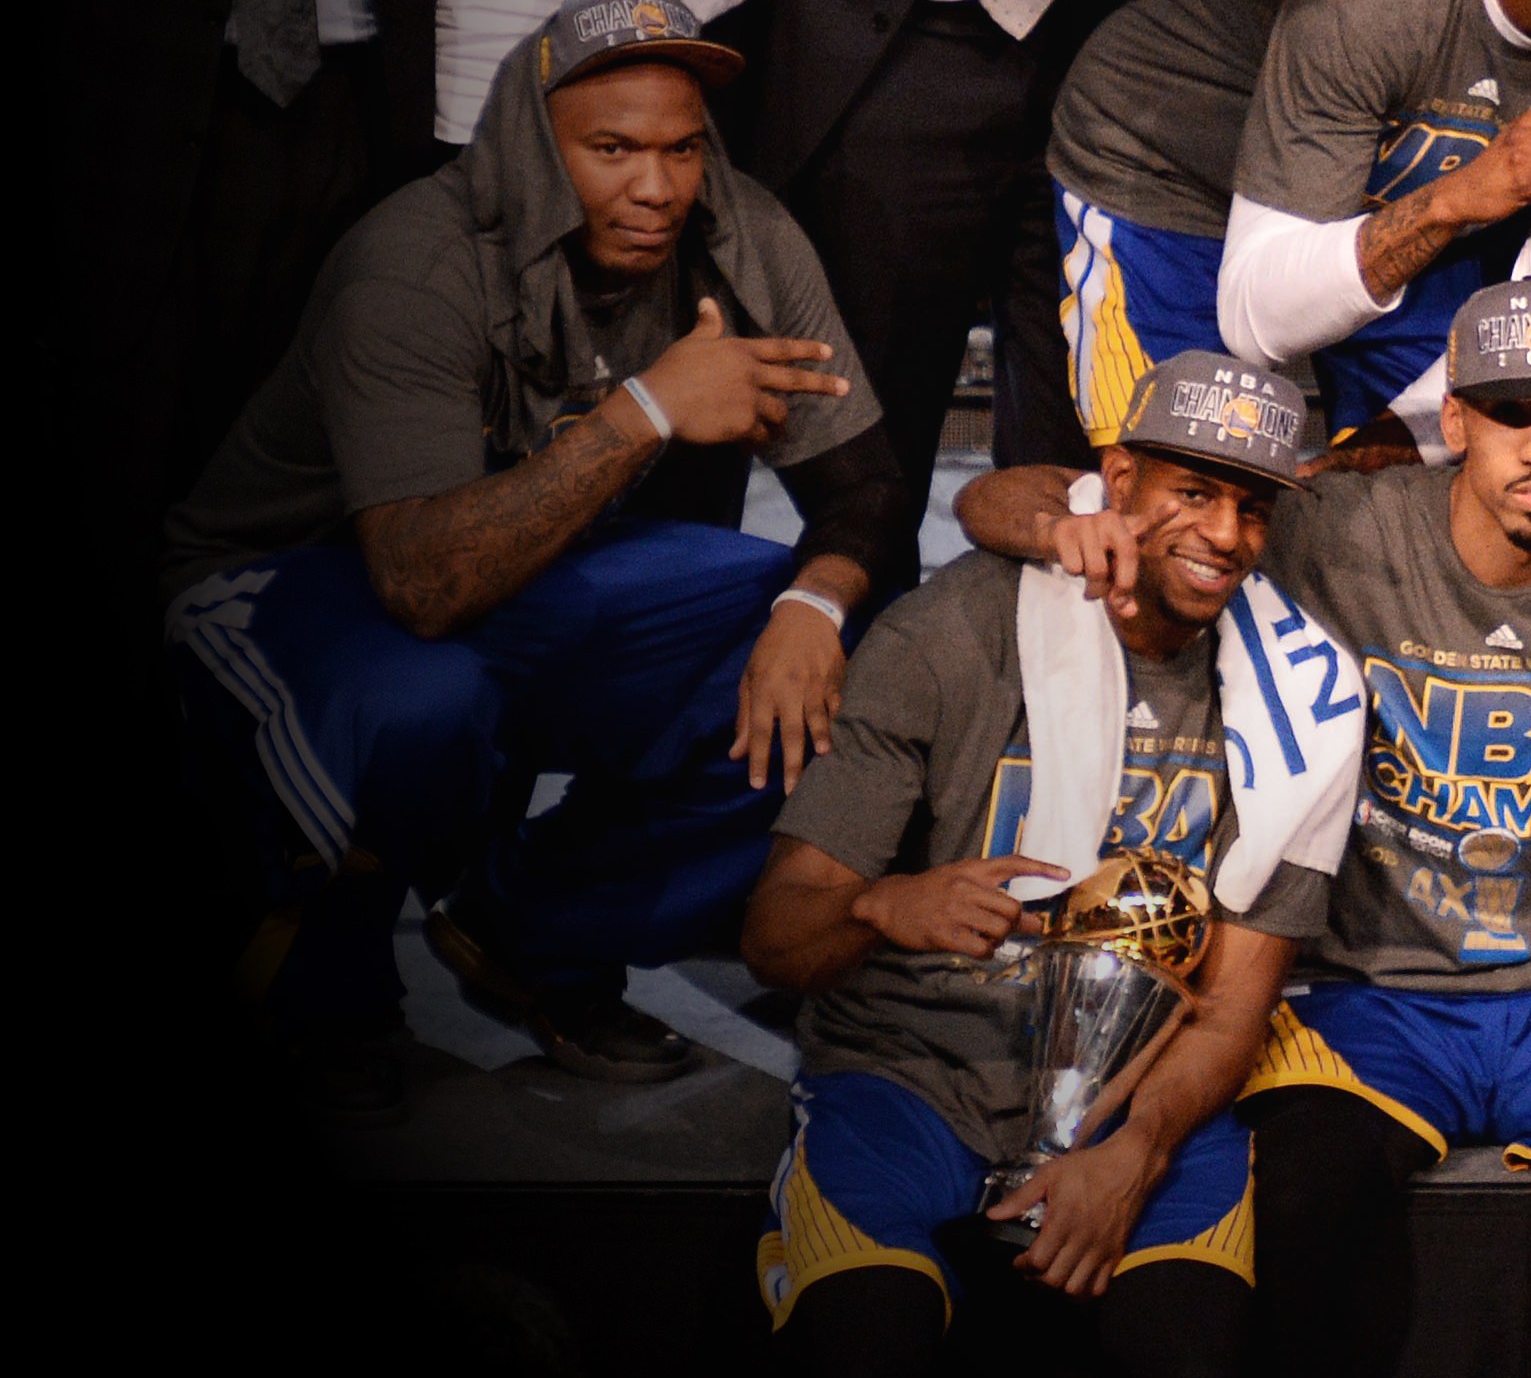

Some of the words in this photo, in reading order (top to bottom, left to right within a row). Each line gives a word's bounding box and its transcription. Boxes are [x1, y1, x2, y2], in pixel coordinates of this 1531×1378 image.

[1214, 369, 1276, 397] NBA
[1401, 640, 1468, 668] GOLDEN
[1471, 654, 1523, 670] STATE
[1409, 866, 1473, 921] 4X
